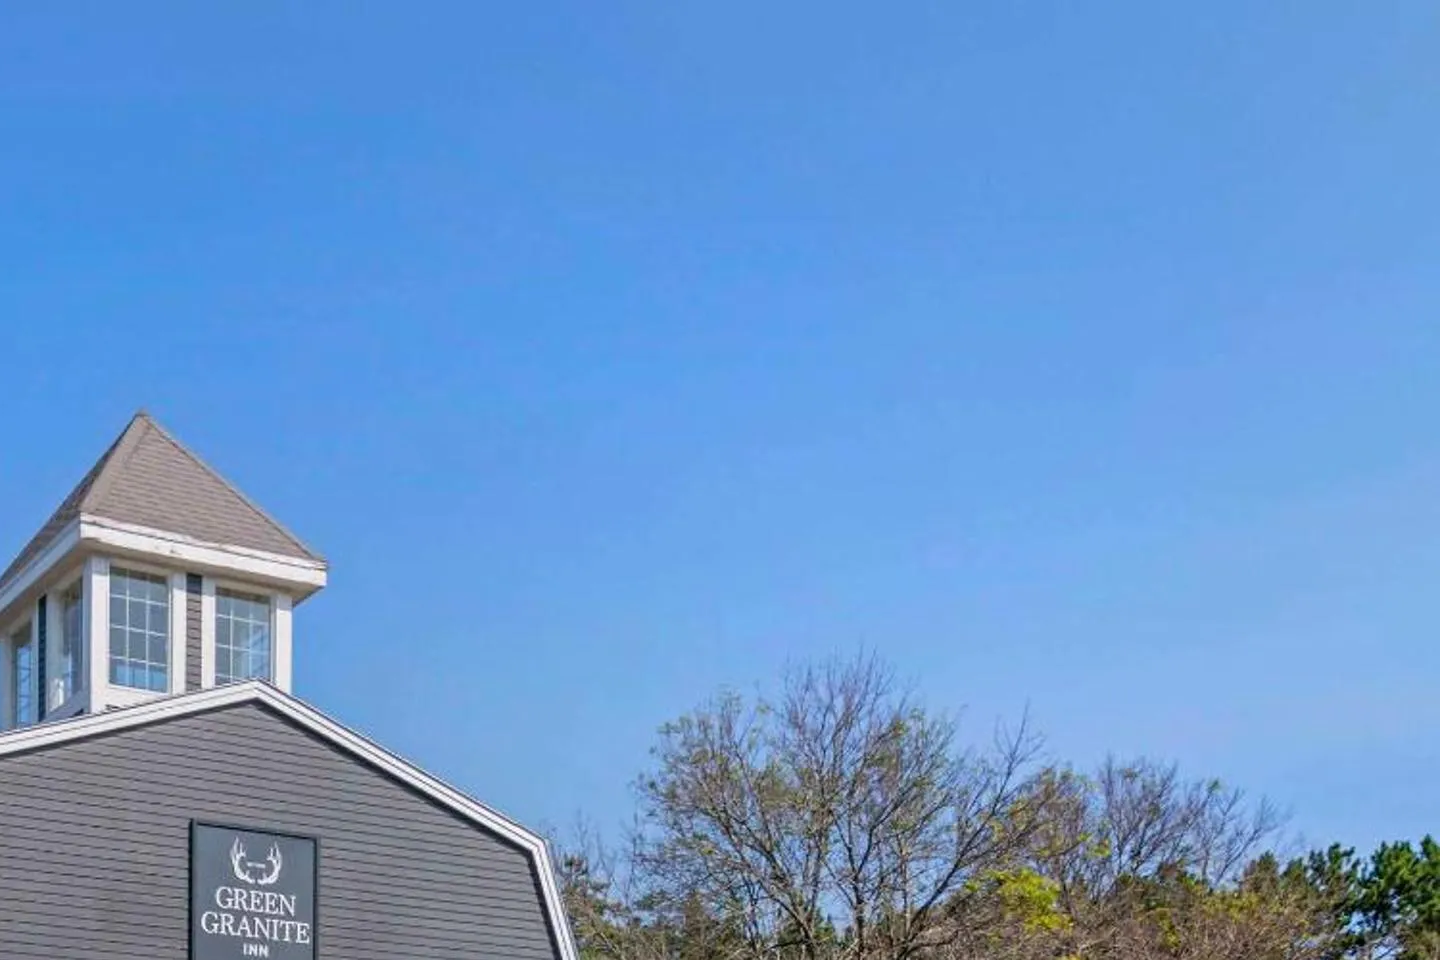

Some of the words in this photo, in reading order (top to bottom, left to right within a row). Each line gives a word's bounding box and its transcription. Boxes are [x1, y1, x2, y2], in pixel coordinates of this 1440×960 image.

[215, 886, 296, 917] GREEN
[201, 911, 310, 944] GRANITE
[243, 944, 269, 957] INN
